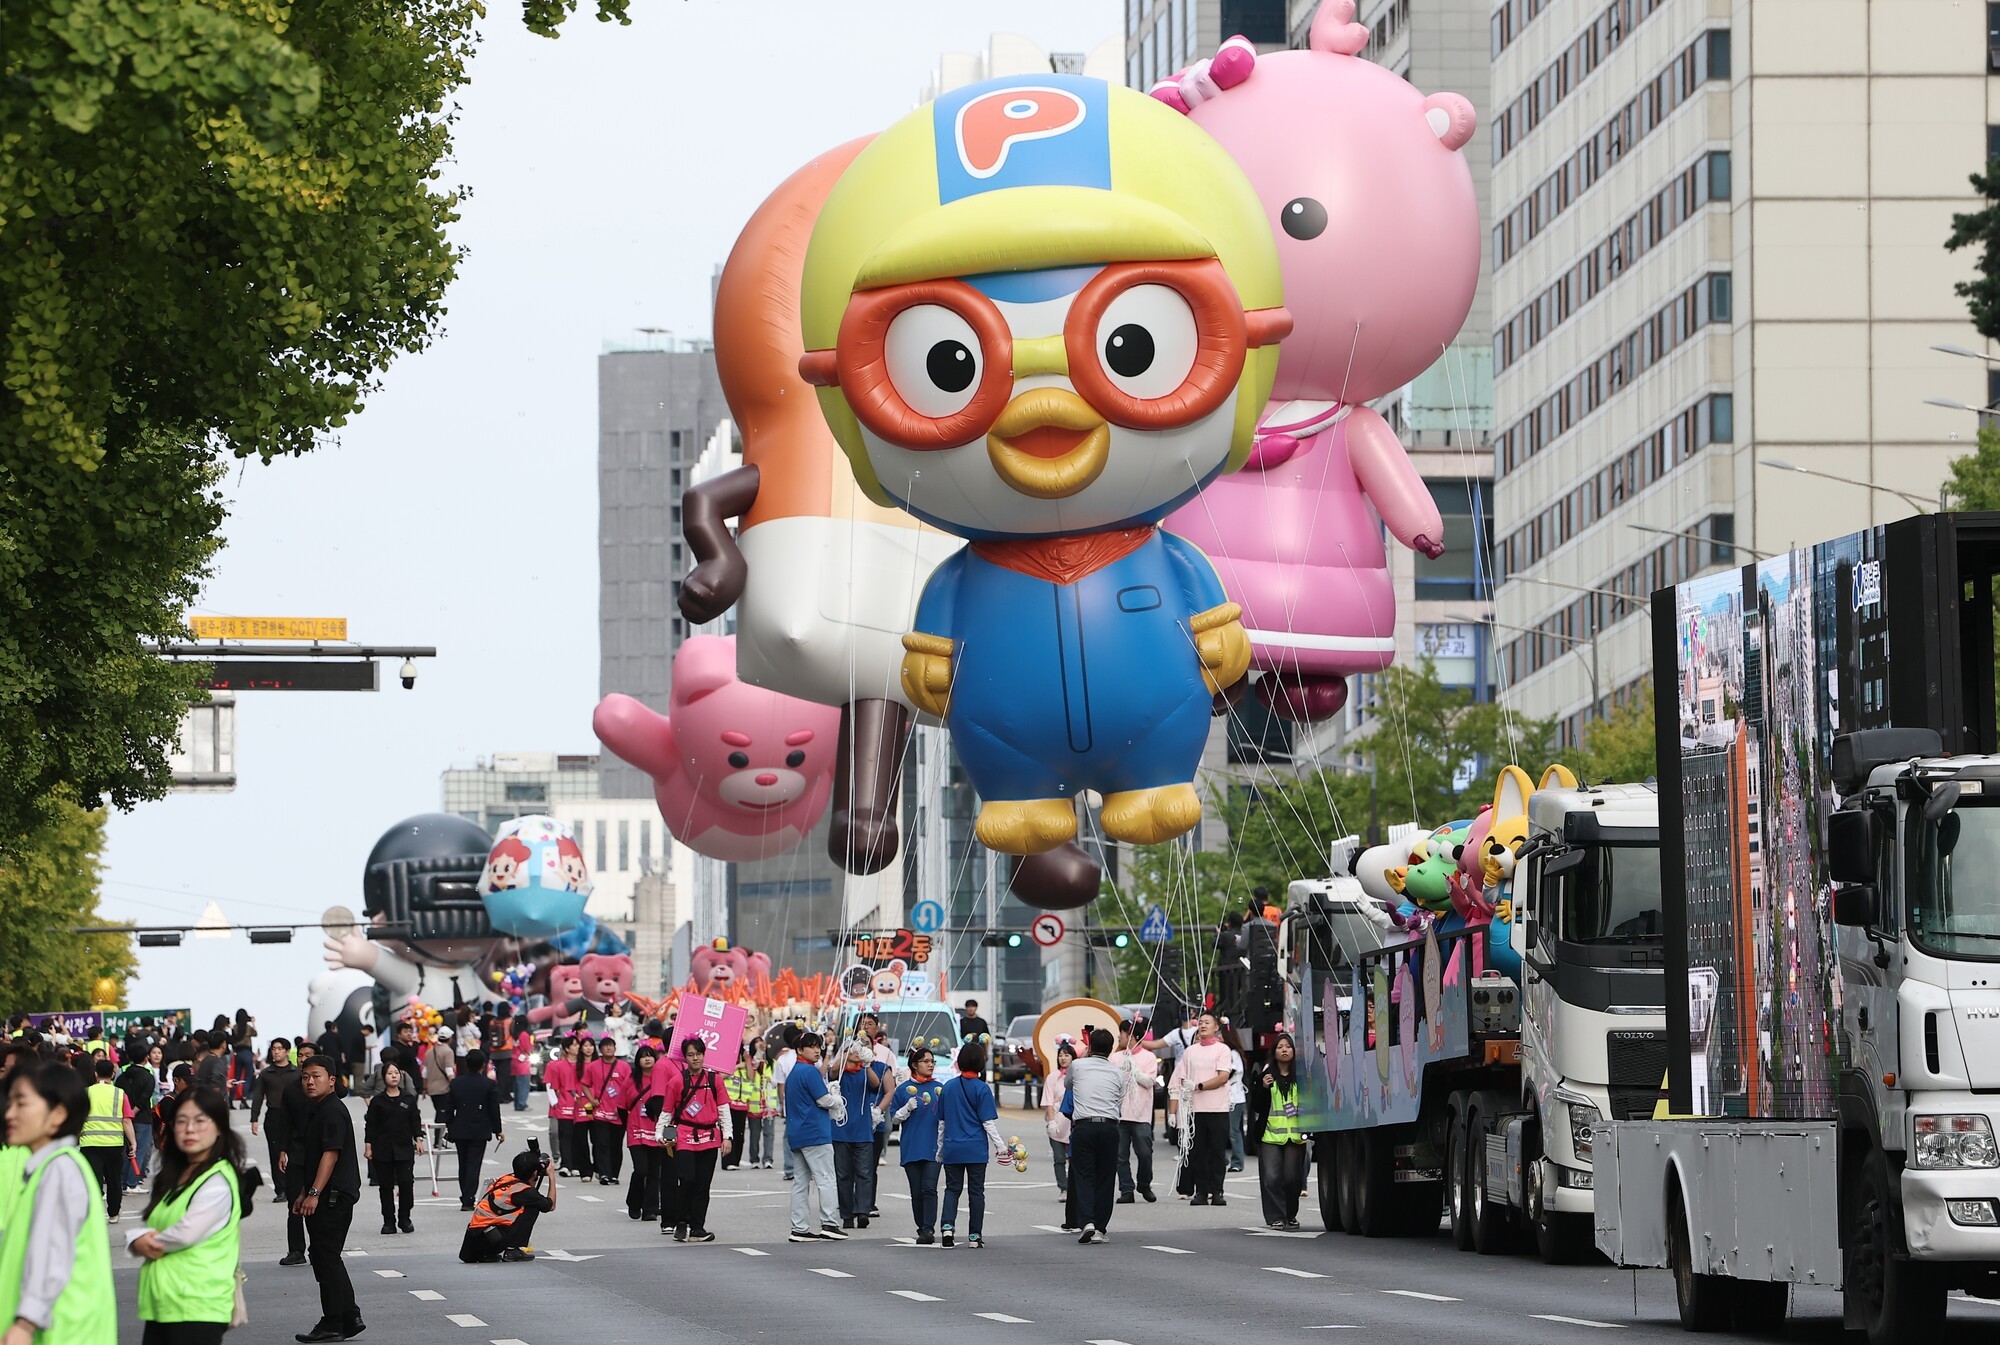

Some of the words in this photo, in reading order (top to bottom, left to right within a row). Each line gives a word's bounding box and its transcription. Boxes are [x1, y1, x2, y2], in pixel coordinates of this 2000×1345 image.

[955, 86, 1087, 179] P
[290, 620, 318, 637] CCTV
[1422, 624, 1466, 639] ZELL
[853, 929, 932, 963] 개포2동
[704, 1019, 718, 1028] UNIT
[695, 1028, 720, 1051] #2
[1613, 1031, 1655, 1040] VOLVO
